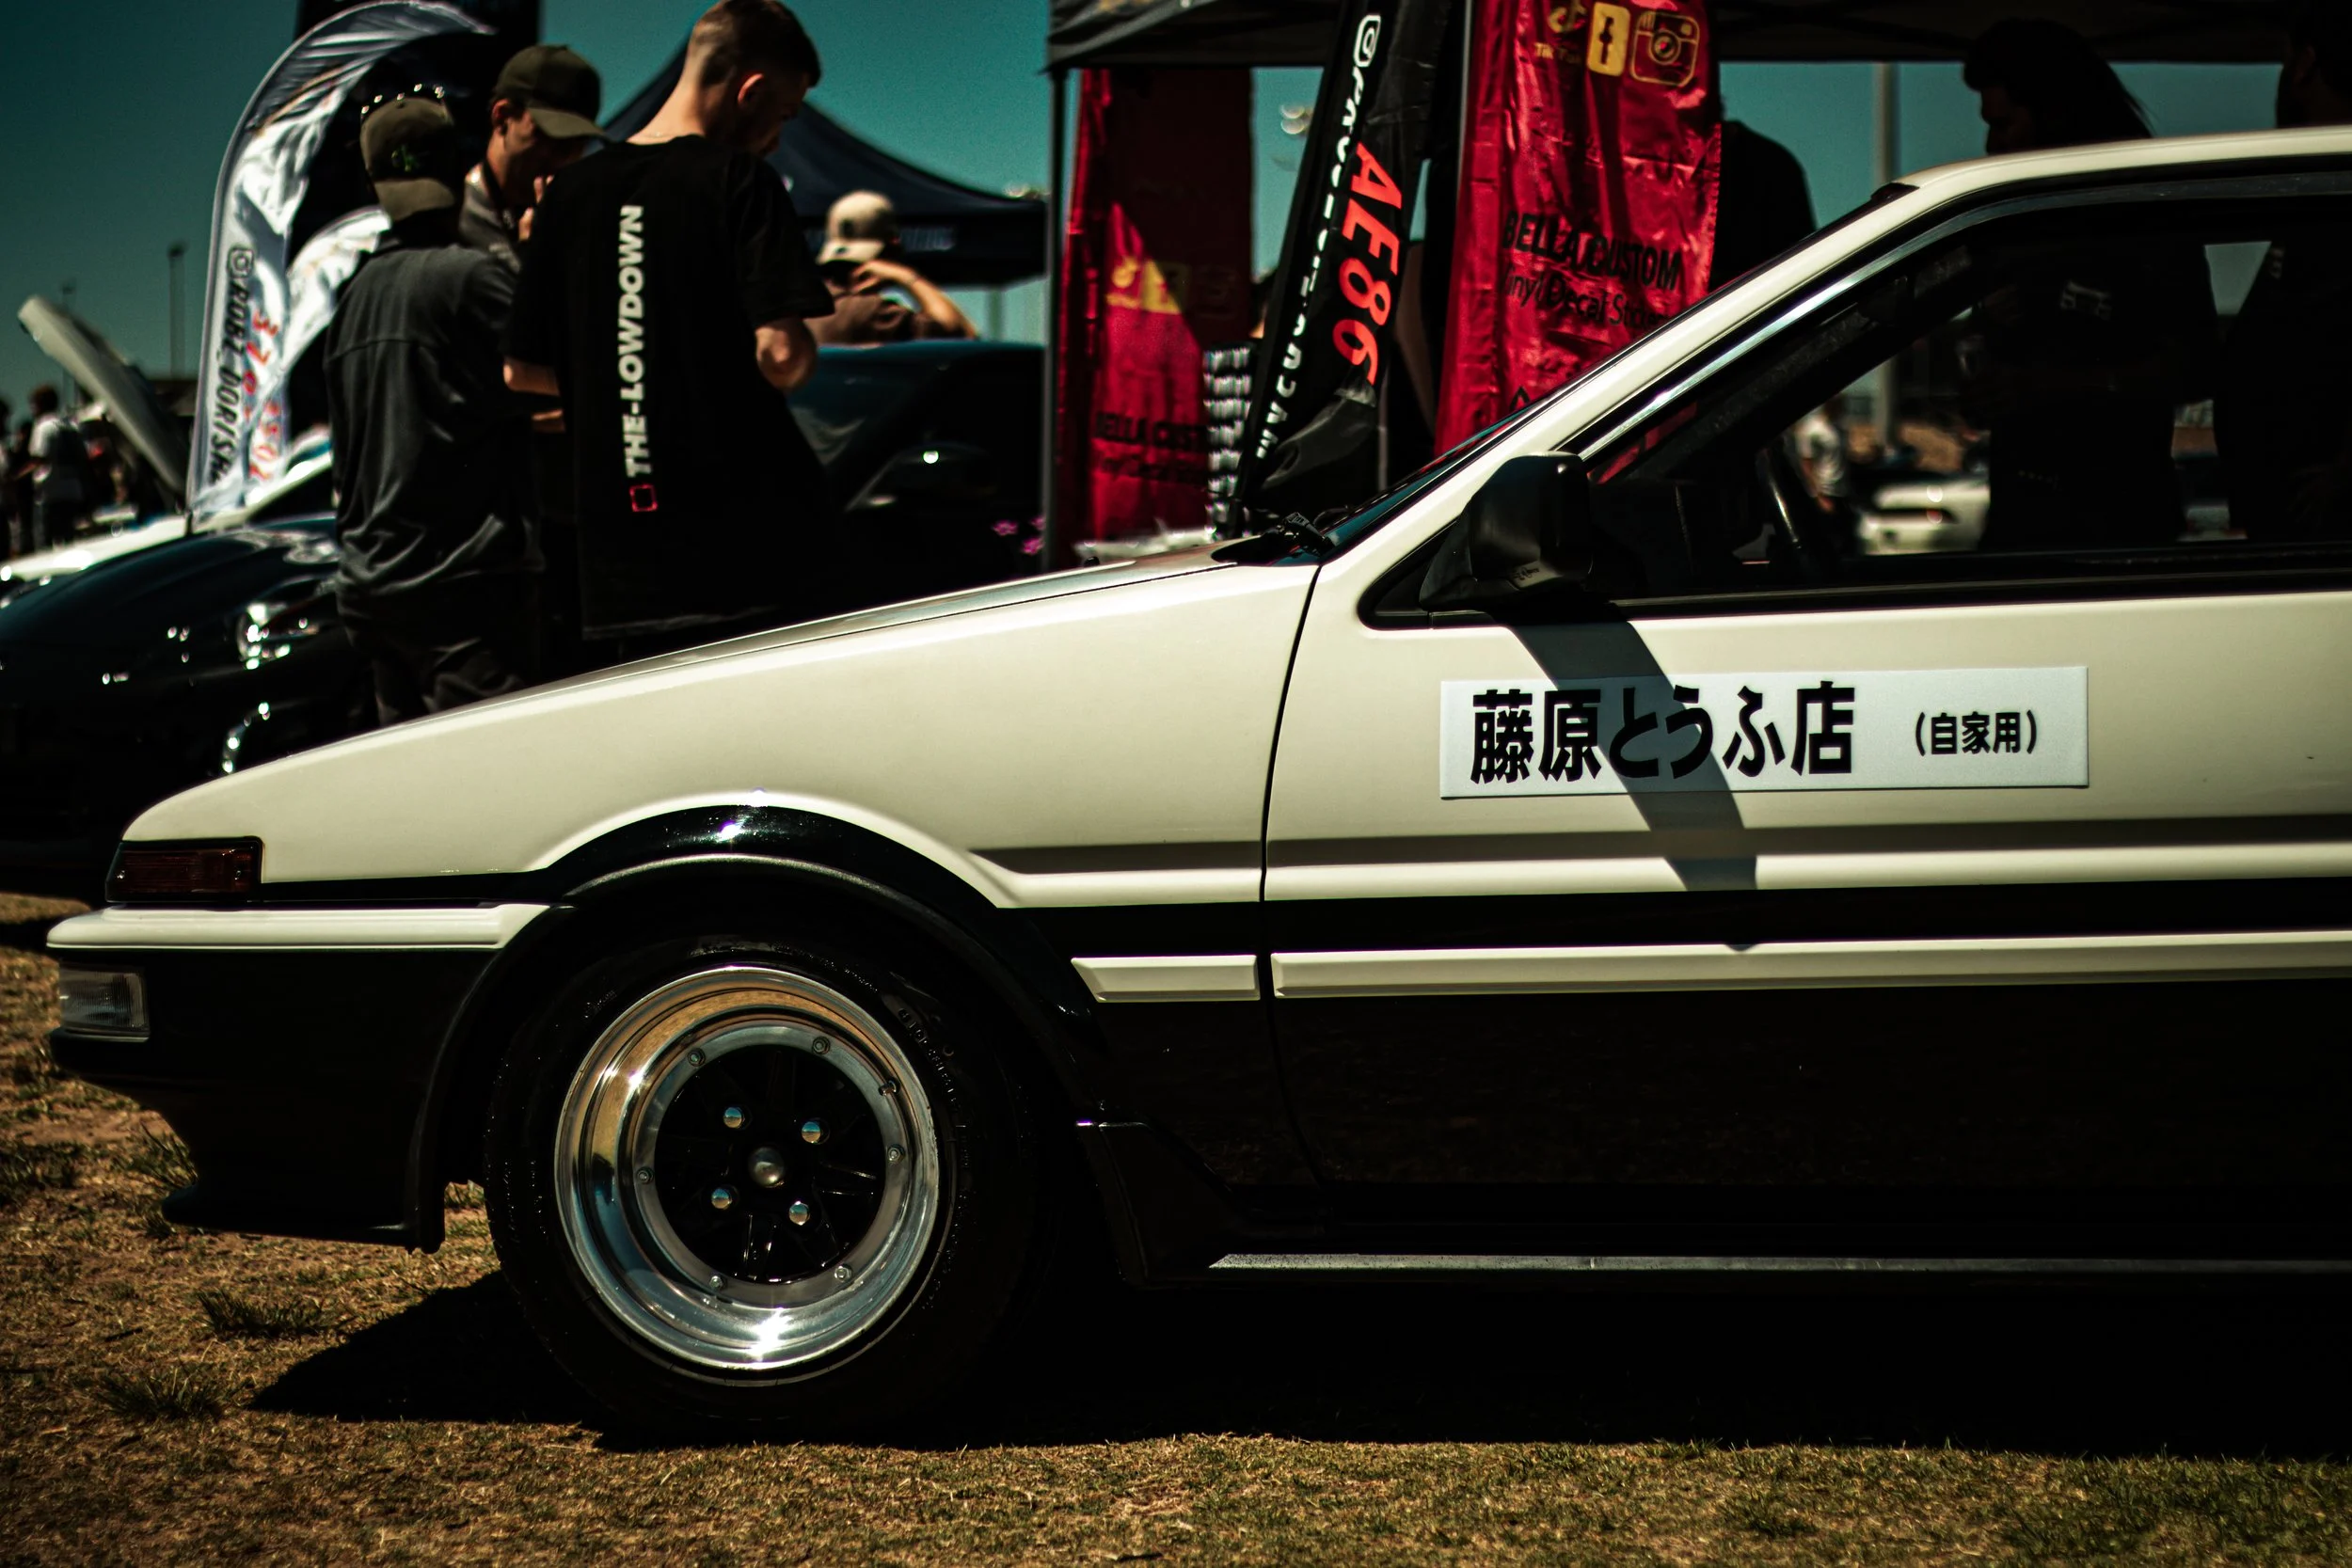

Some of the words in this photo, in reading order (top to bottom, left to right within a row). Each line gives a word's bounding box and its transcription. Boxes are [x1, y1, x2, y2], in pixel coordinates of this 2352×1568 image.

[1331, 140, 1404, 387] AE86
[1502, 210, 1581, 269] BELLA
[1586, 235, 1681, 291] CUSTOM
[617, 204, 654, 479] THE-LOWDOWN
[1470, 681, 1856, 784] 藤原とうふ店
